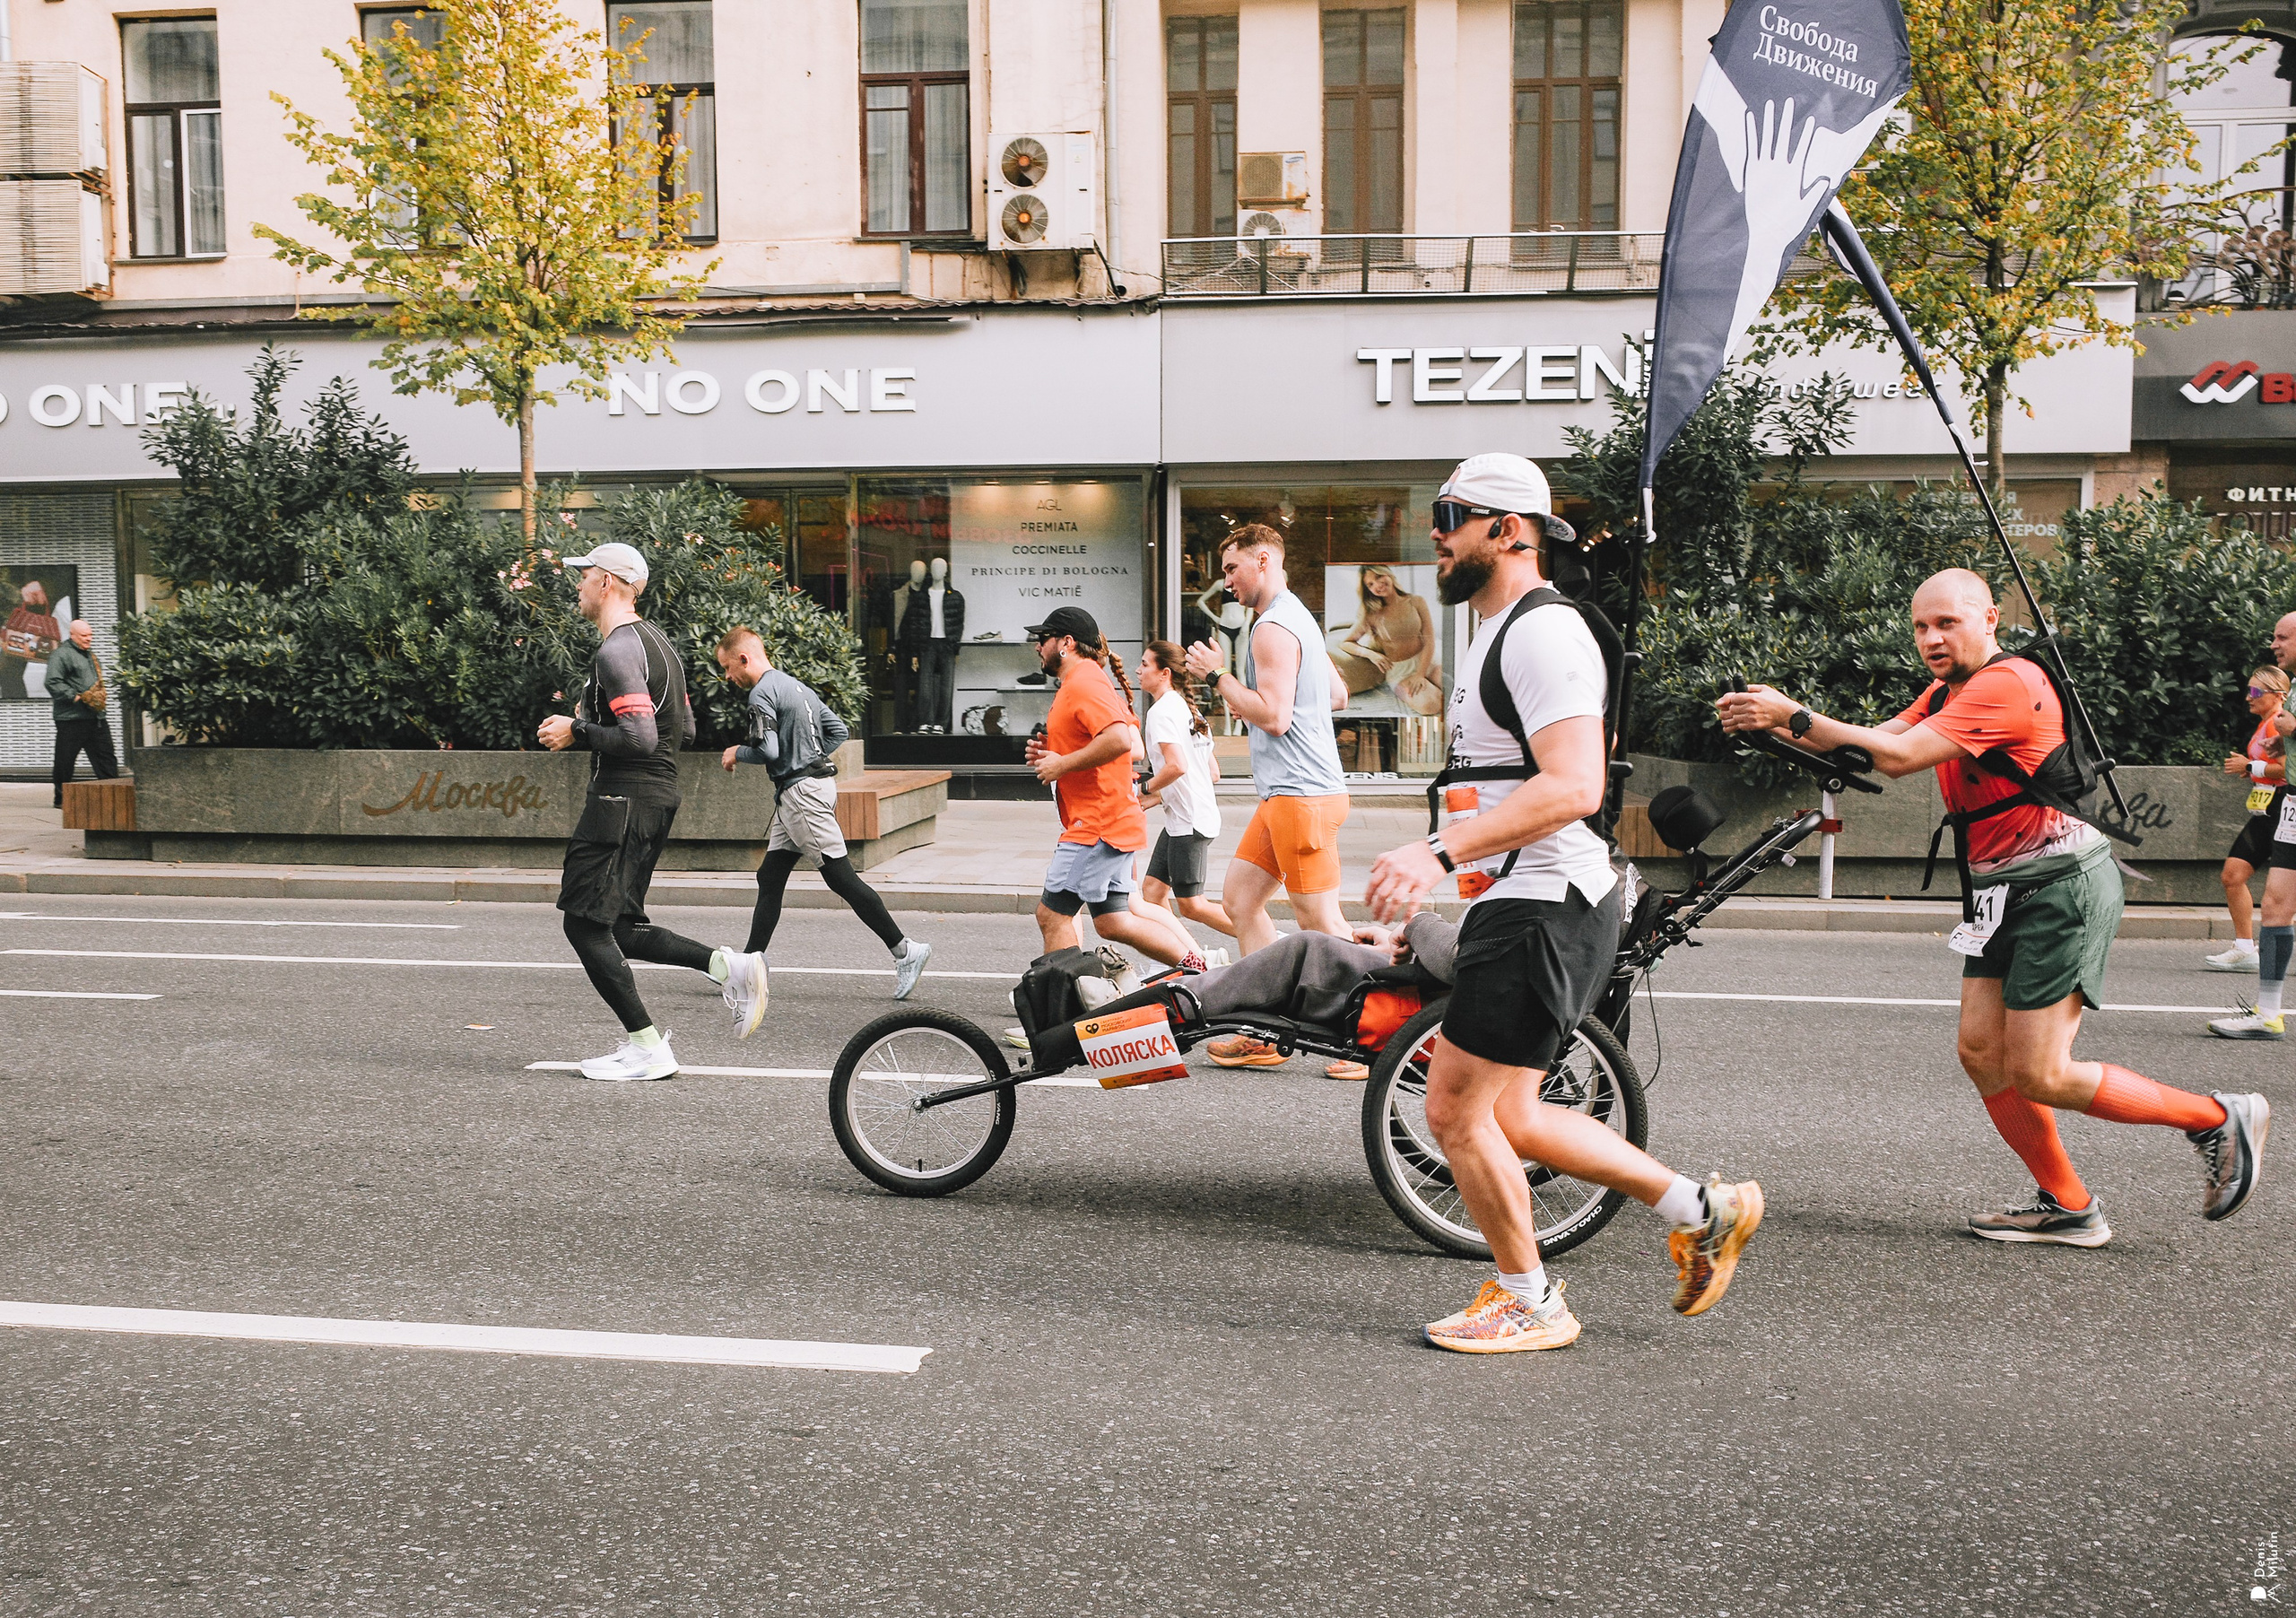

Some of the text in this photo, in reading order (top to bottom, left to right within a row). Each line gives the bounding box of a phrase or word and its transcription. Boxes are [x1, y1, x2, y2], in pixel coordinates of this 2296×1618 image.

[1759, 4, 1859, 63] Свобода
[1752, 31, 1879, 99] Движения
[1357, 328, 1656, 404] TEZENi
[608, 367, 917, 416] NO ONE
[1747, 378, 1944, 399] ndrwea
[2261, 373, 2296, 404] B
[1036, 499, 1063, 511] AGL
[1020, 521, 1079, 533] PREMIATA
[1012, 544, 1088, 555] COCCINELLE
[971, 566, 1129, 577] PRINCIPE DI BOLOGNA
[1018, 587, 1040, 597] VIC
[1344, 771, 1399, 779] ZENIS
[361, 770, 549, 818] Москва
[2283, 806, 2296, 822] 12
[1086, 1034, 1177, 1069] КОЛЯСКА
